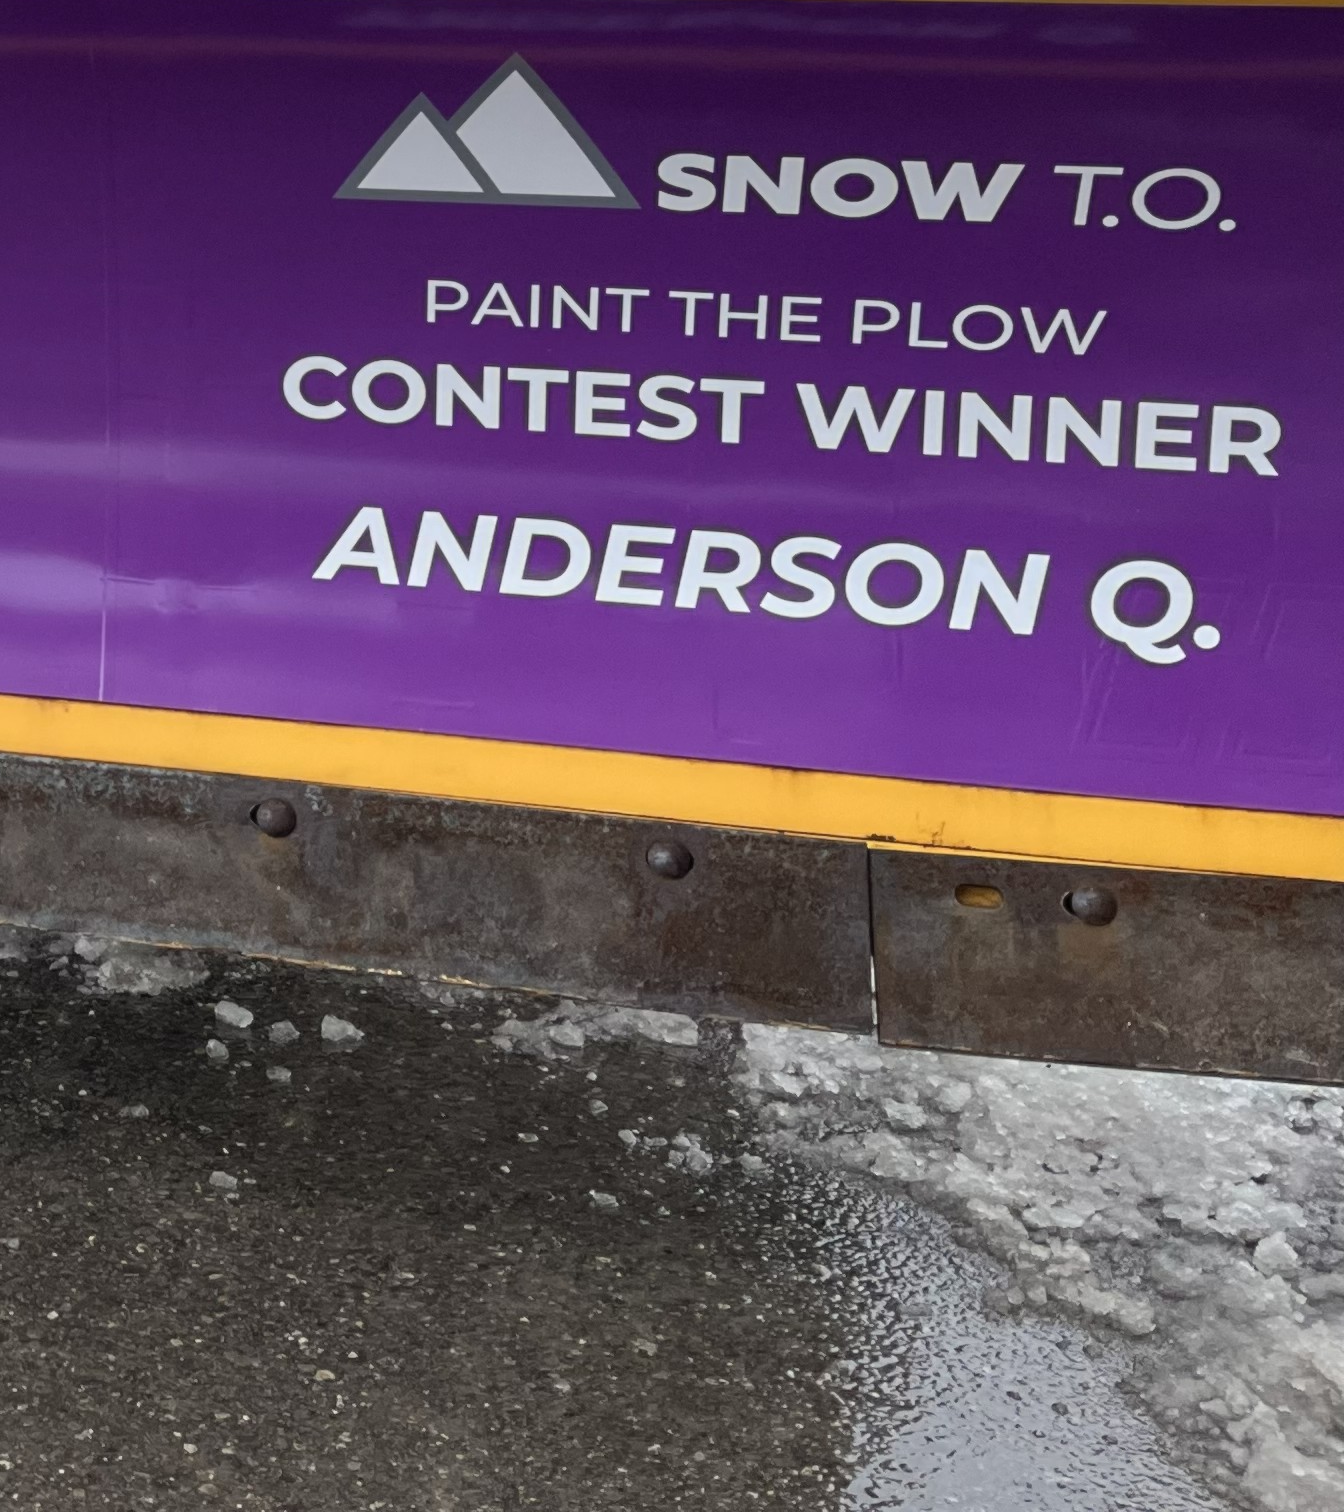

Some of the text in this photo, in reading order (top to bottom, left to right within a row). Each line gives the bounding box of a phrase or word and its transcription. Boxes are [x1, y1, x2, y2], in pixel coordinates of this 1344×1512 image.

[657, 153, 1237, 232] SNOW T.O.
[426, 279, 1108, 356] PAINT THE PLOW
[282, 355, 1282, 477] CONTEST WINNER
[312, 506, 1221, 665] ANDERSON Q.
